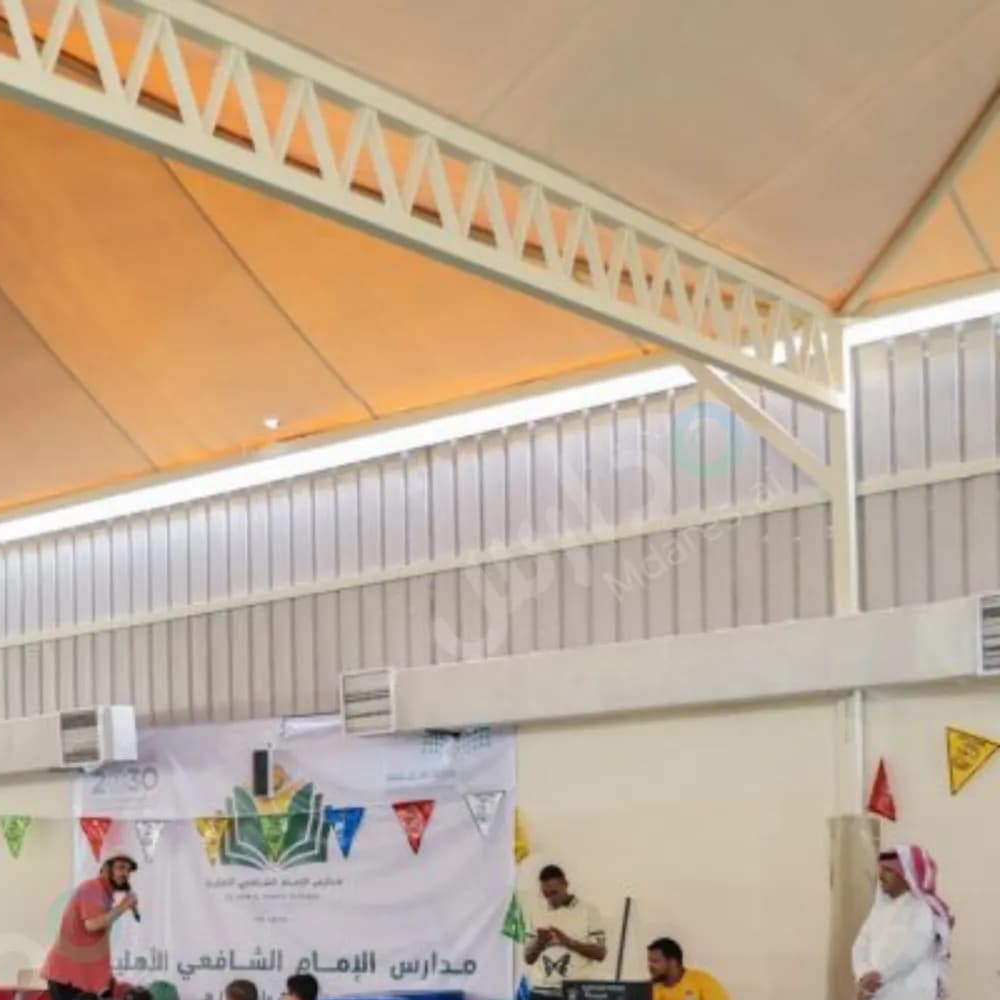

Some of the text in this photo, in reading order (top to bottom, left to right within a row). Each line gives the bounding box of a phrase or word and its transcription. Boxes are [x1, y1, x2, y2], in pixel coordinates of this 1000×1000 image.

[113, 945, 168, 977] الأهلي
[176, 945, 283, 981] الشافعي
[389, 950, 477, 981] مدارس
